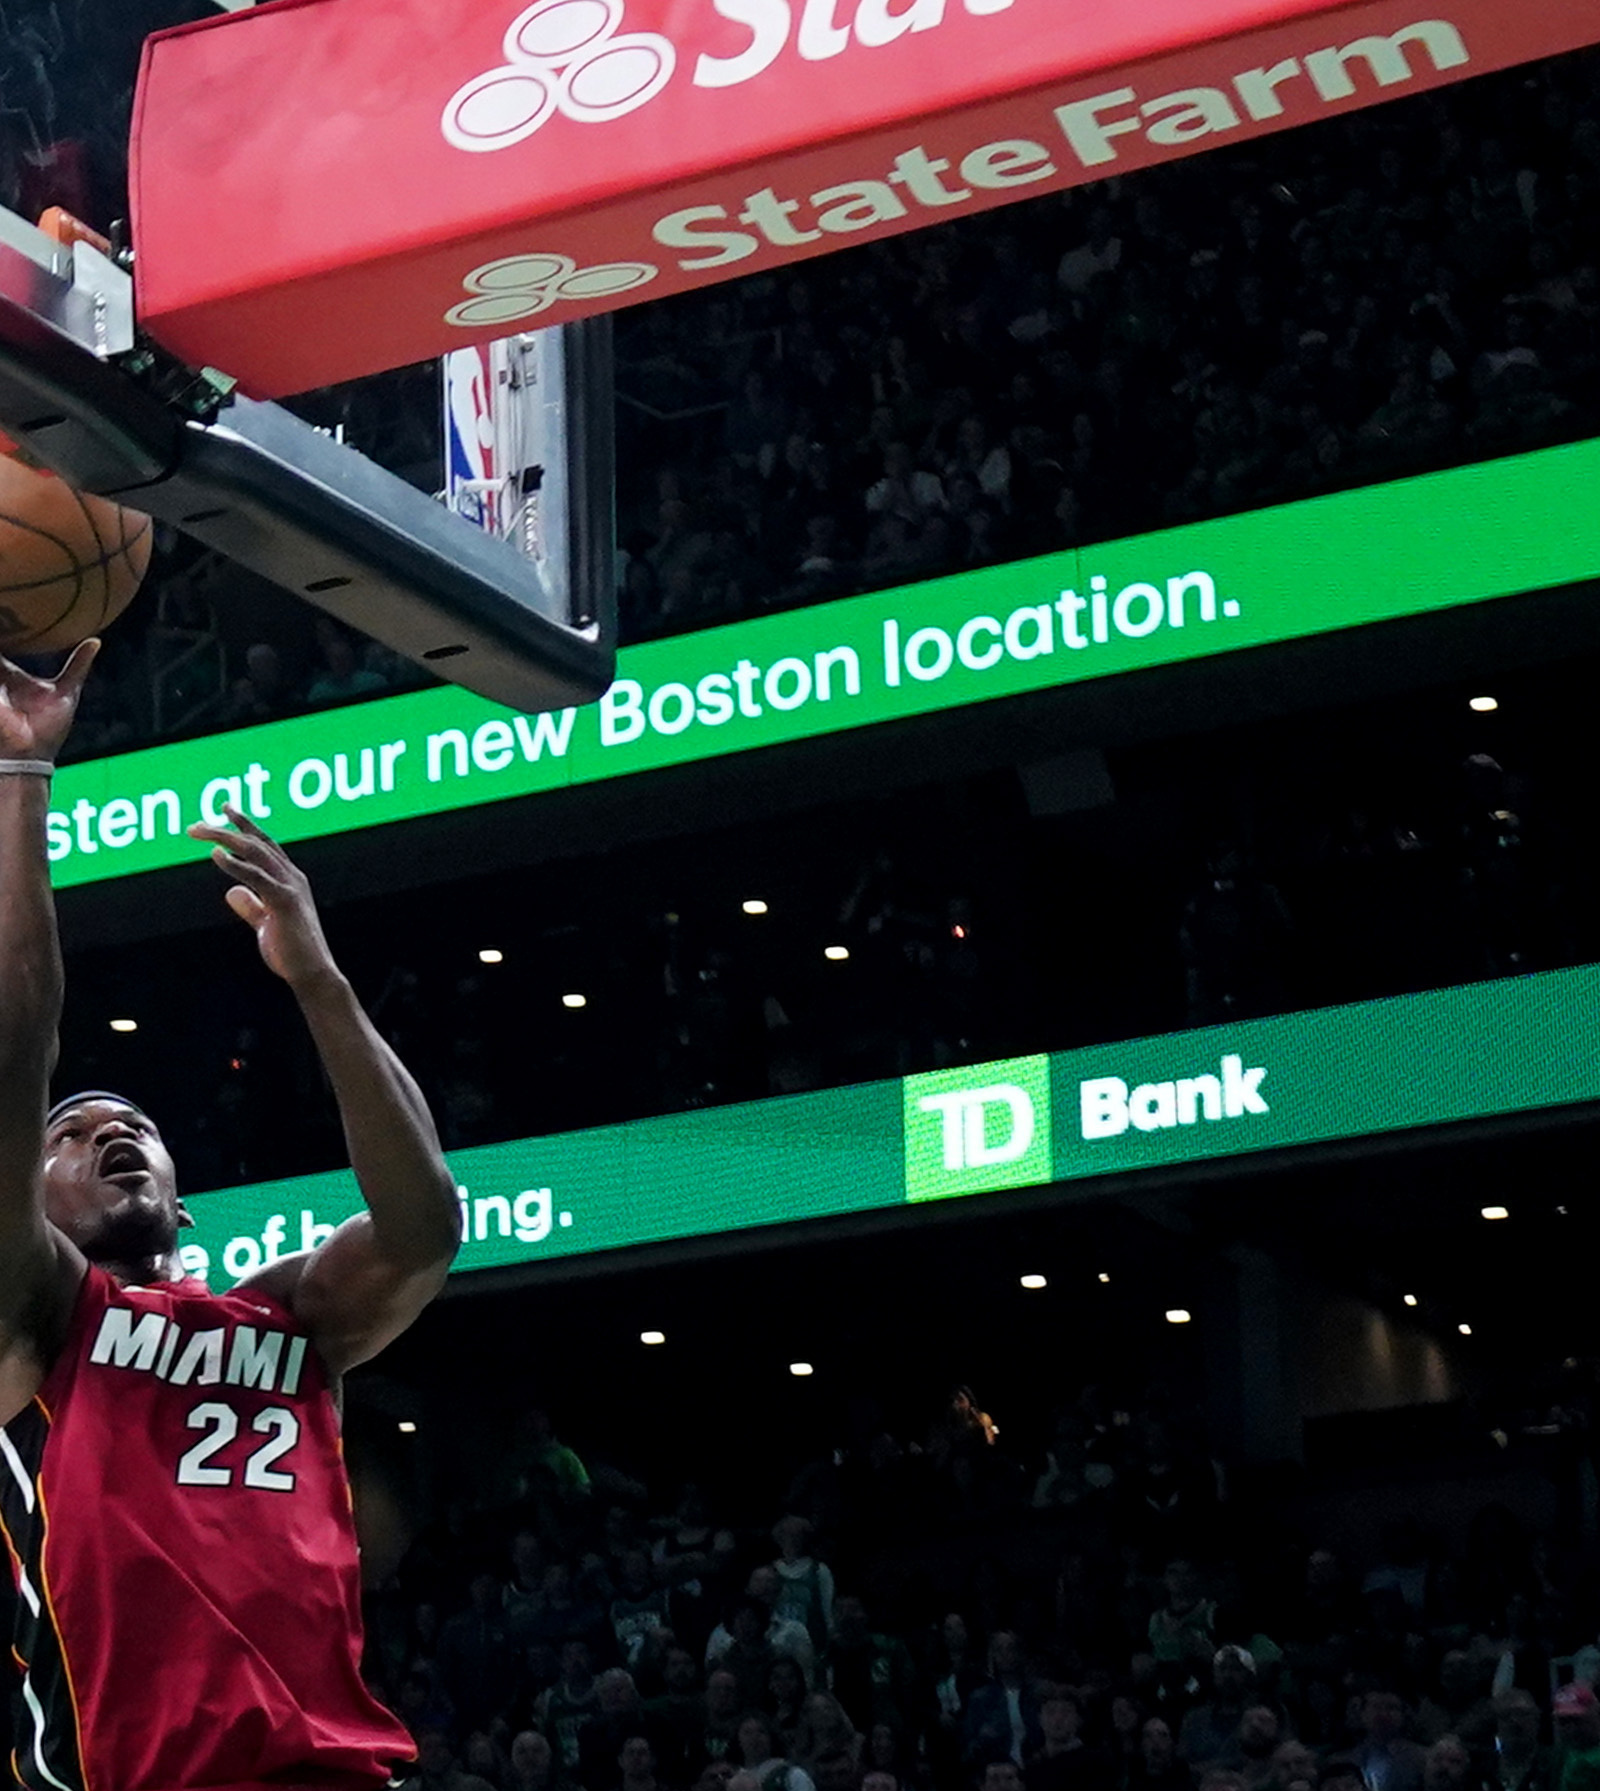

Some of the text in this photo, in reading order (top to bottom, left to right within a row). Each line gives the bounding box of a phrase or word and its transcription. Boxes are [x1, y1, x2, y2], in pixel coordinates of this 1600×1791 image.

[286, 739, 407, 810] our
[426, 705, 575, 781] new
[599, 646, 862, 745] Boston
[883, 567, 1241, 688] location.
[918, 1054, 1269, 1172] TD Bank
[90, 1306, 308, 1395] MIAMI
[176, 1401, 300, 1491] 22
